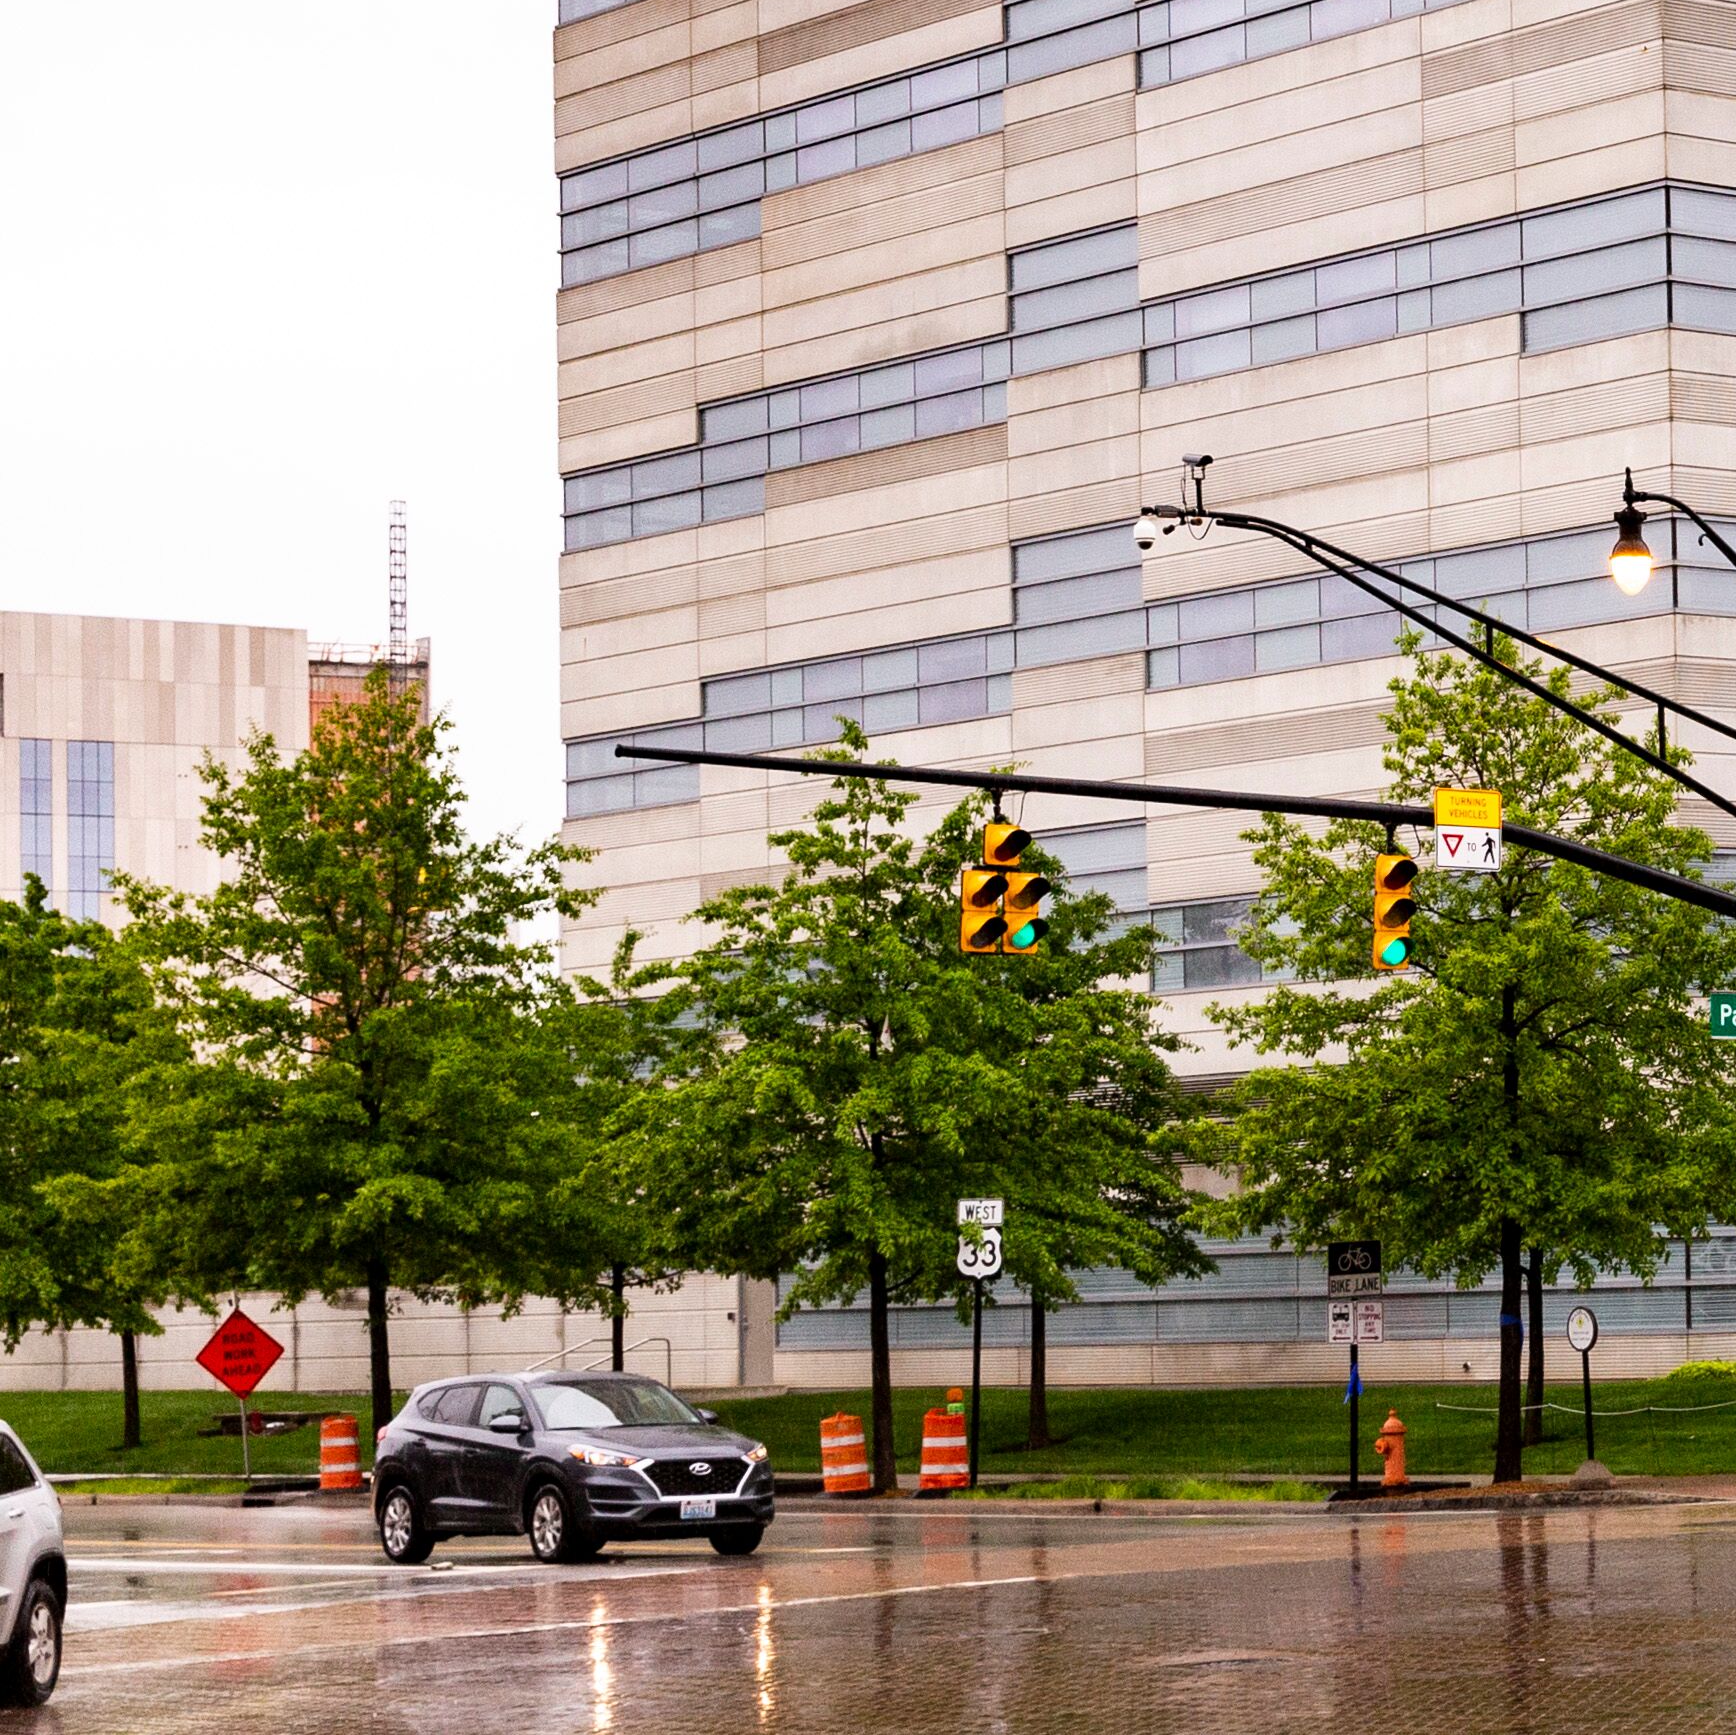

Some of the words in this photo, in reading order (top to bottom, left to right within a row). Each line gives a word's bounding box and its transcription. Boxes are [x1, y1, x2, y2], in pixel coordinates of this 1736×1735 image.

[1450, 796, 1487, 807] TURNING
[1449, 809, 1488, 820] VEHICLES
[1467, 842, 1477, 852] TO
[965, 1205, 996, 1220] WEST
[962, 1240, 997, 1267] 33
[1330, 1278, 1351, 1293] BIKE
[1355, 1277, 1380, 1292] LANE
[222, 1332, 255, 1343] ROAD
[224, 1349, 255, 1360] WORK
[223, 1363, 260, 1376] AHEAD
